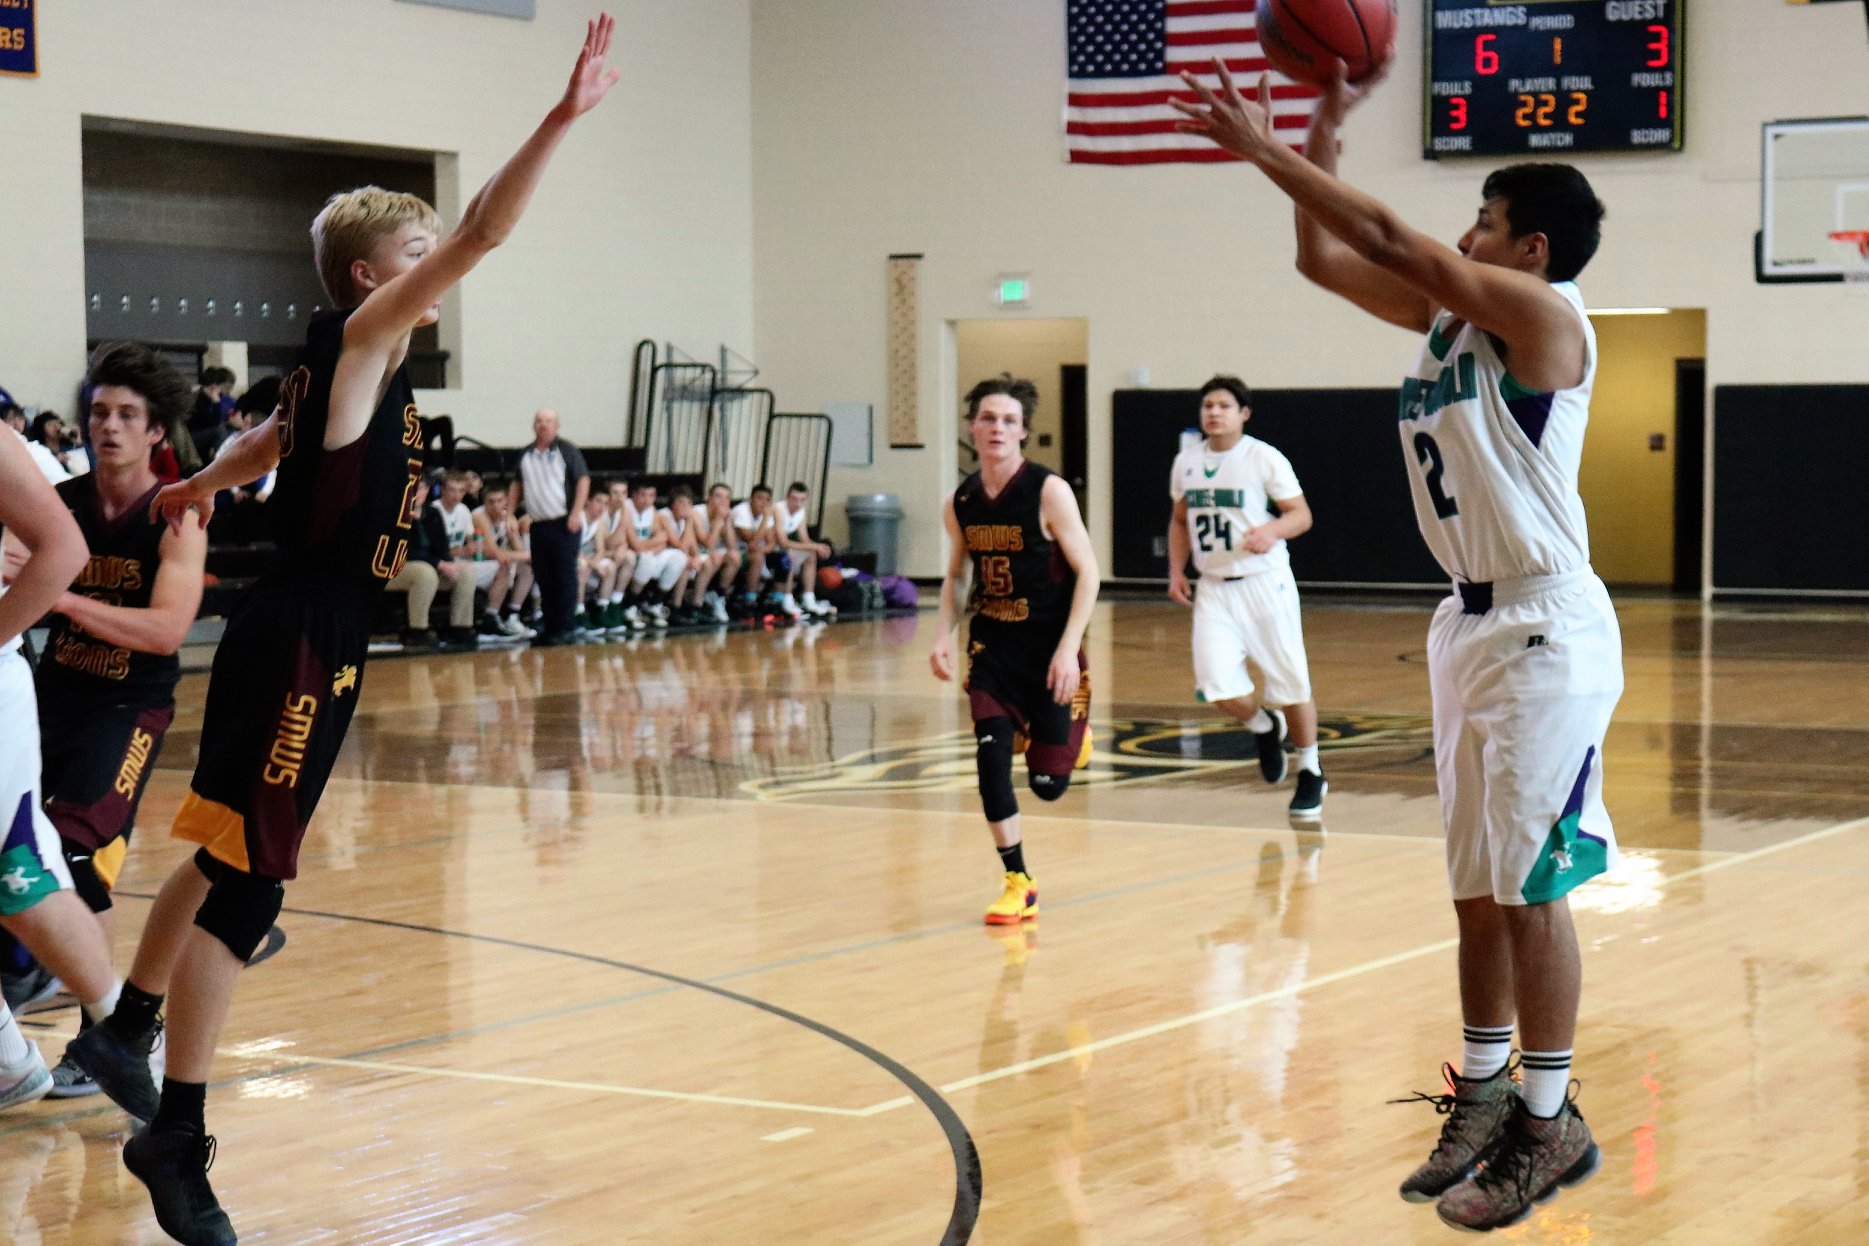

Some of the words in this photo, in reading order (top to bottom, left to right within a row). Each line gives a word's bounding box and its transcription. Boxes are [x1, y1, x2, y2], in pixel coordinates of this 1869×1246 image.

[1435, 5, 1527, 29] MUSTANGS
[1529, 14, 1575, 31] PERIOD
[1605, 0, 1667, 21] GUEST
[1475, 33, 1499, 75] 6
[1553, 36, 1562, 65] 1
[1647, 25, 1669, 67] 3
[1431, 81, 1472, 96] FOULS
[1508, 76, 1557, 93] PLAYER
[1561, 75, 1595, 91] FOUL
[1631, 71, 1674, 88] FOULS
[1448, 96, 1467, 130] 3
[1658, 90, 1668, 119] 1
[1433, 136, 1472, 151] SCORE
[1528, 132, 1574, 148] MATCH
[1413, 432, 1460, 520] 2
[1195, 512, 1233, 551] 24
[982, 555, 1014, 596] 15
